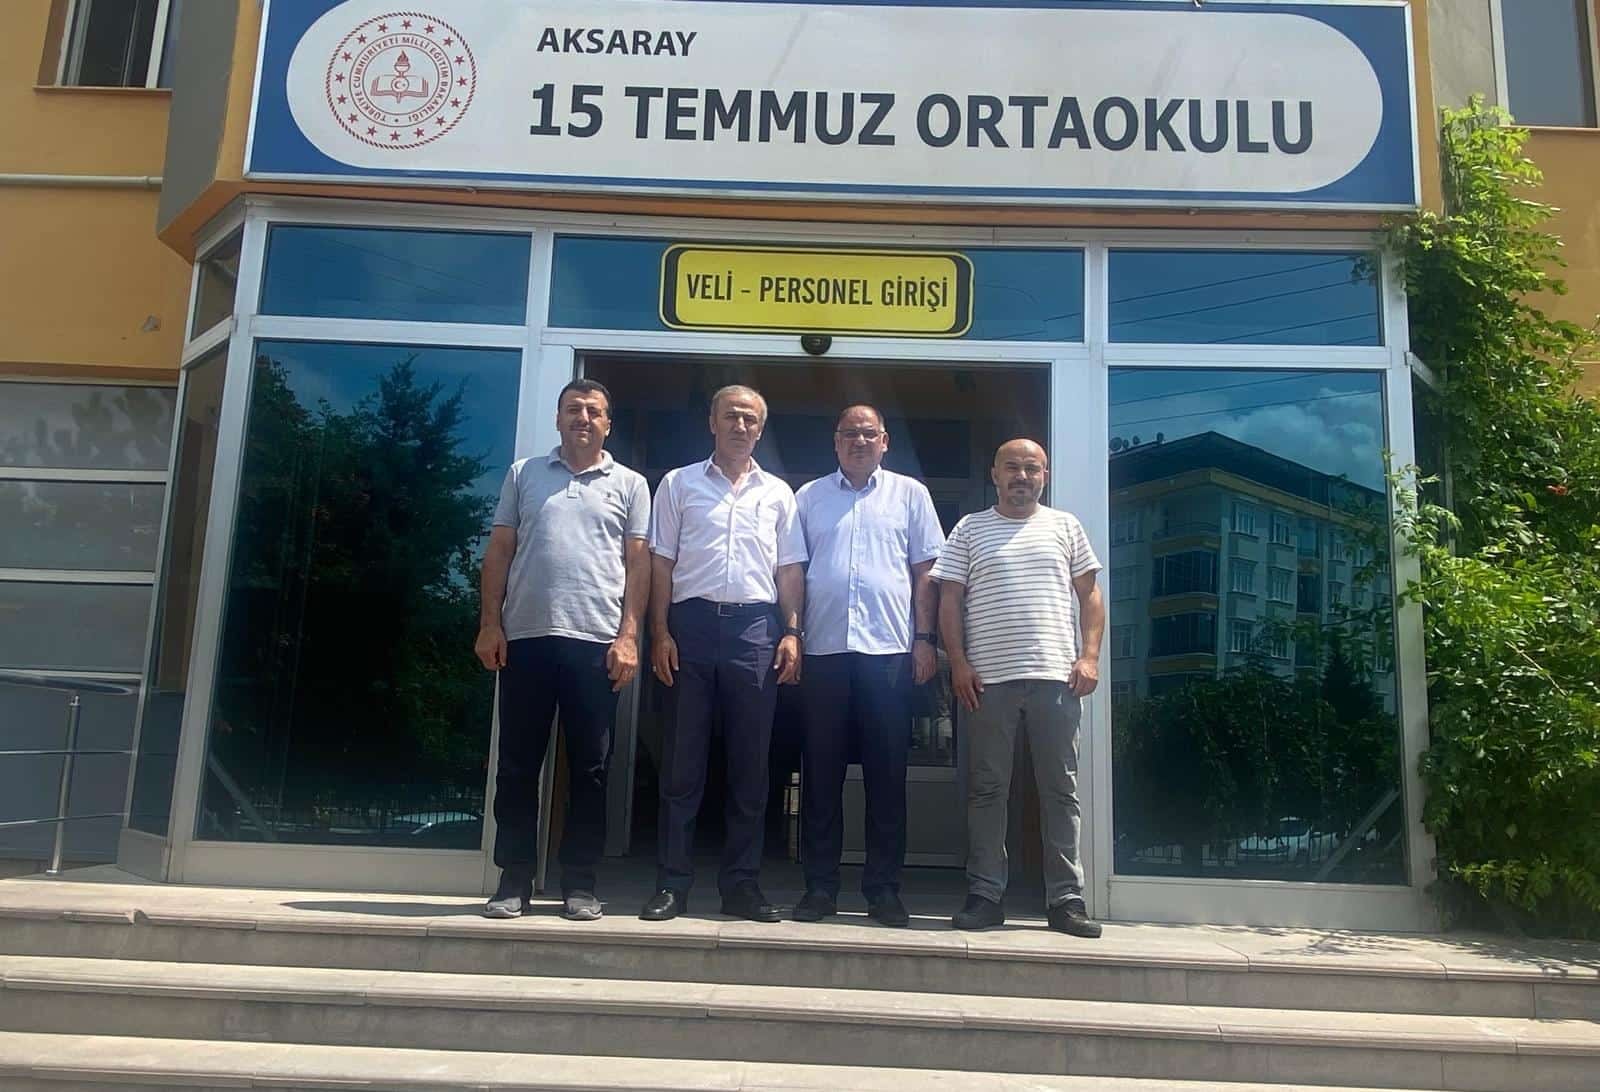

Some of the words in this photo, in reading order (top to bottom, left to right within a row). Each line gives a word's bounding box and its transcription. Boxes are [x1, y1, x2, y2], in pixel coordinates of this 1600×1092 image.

[536, 27, 697, 57] AKSARAY
[530, 83, 604, 138] 15
[624, 86, 896, 147] TEMMUZ
[916, 93, 1313, 155] ORTAOKULU
[686, 271, 733, 301] VELİ
[759, 276, 873, 306] PERSONEL
[881, 276, 948, 312] GİRİŞİ
